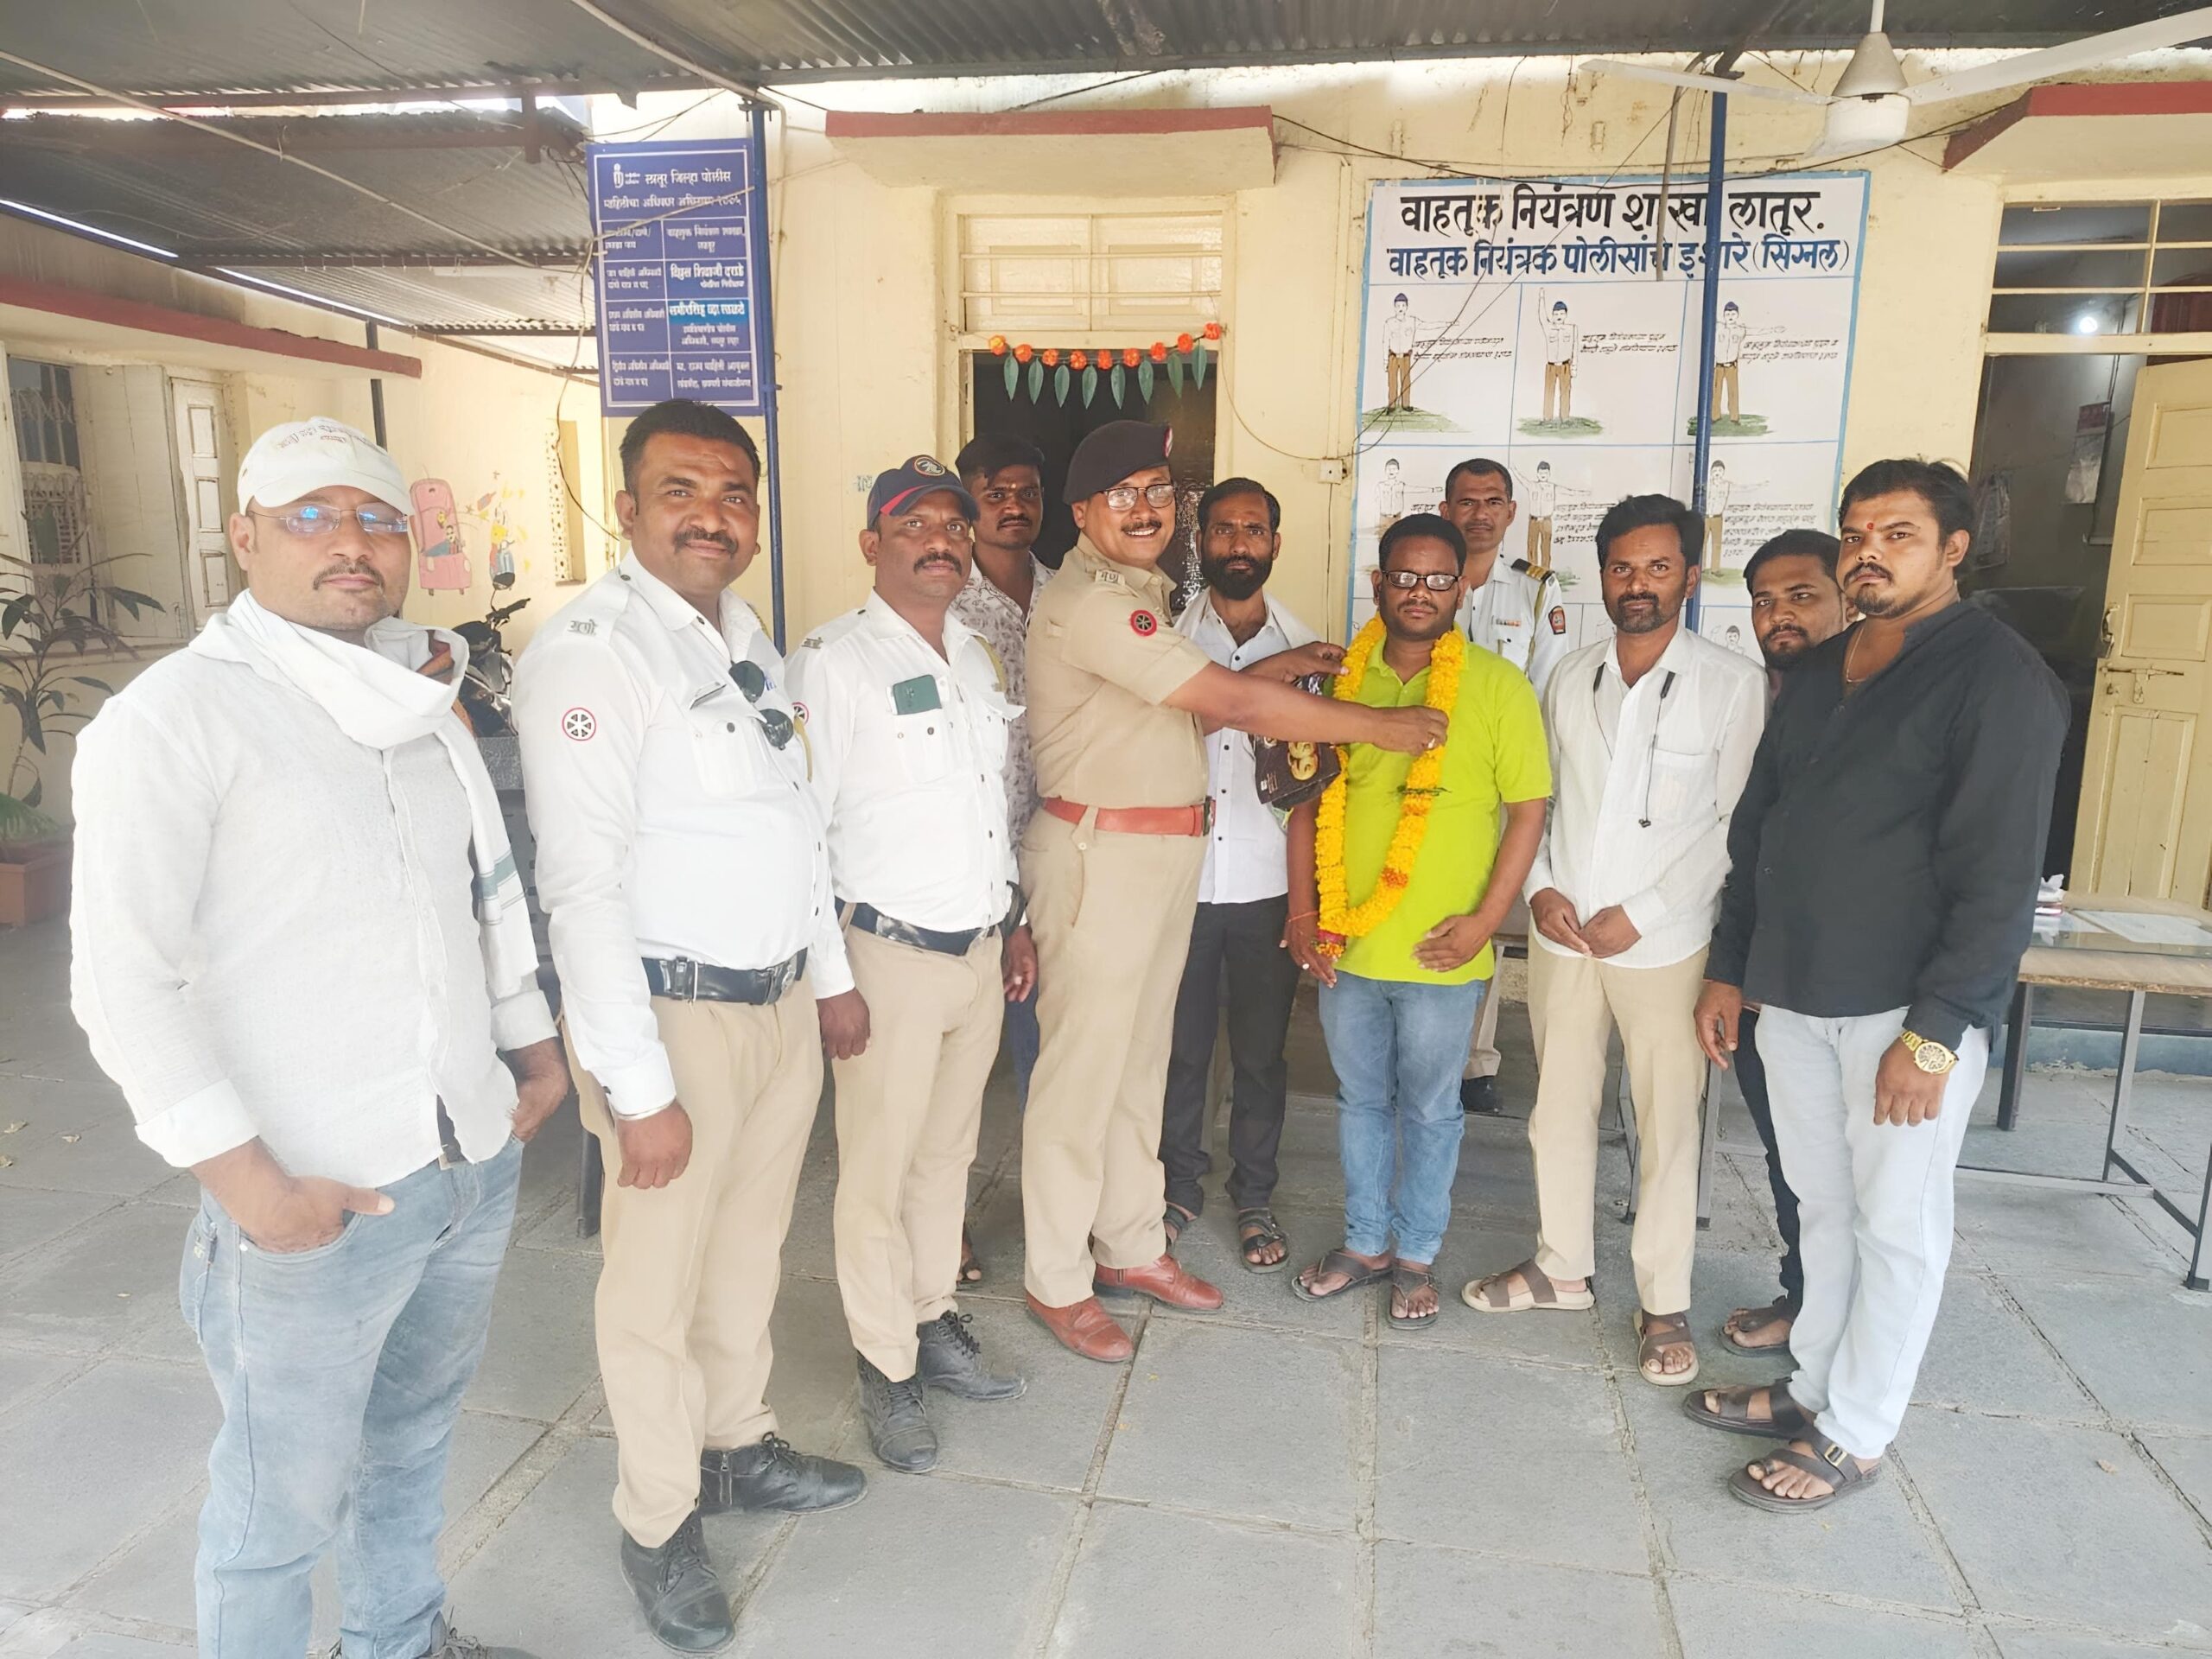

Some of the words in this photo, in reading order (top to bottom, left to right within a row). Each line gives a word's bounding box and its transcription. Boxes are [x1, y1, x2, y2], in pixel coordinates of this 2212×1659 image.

[1512, 183, 1617, 230] नियंत्रण
[1622, 193, 1708, 232] शखा
[1473, 236, 1557, 276] नियंत्रक
